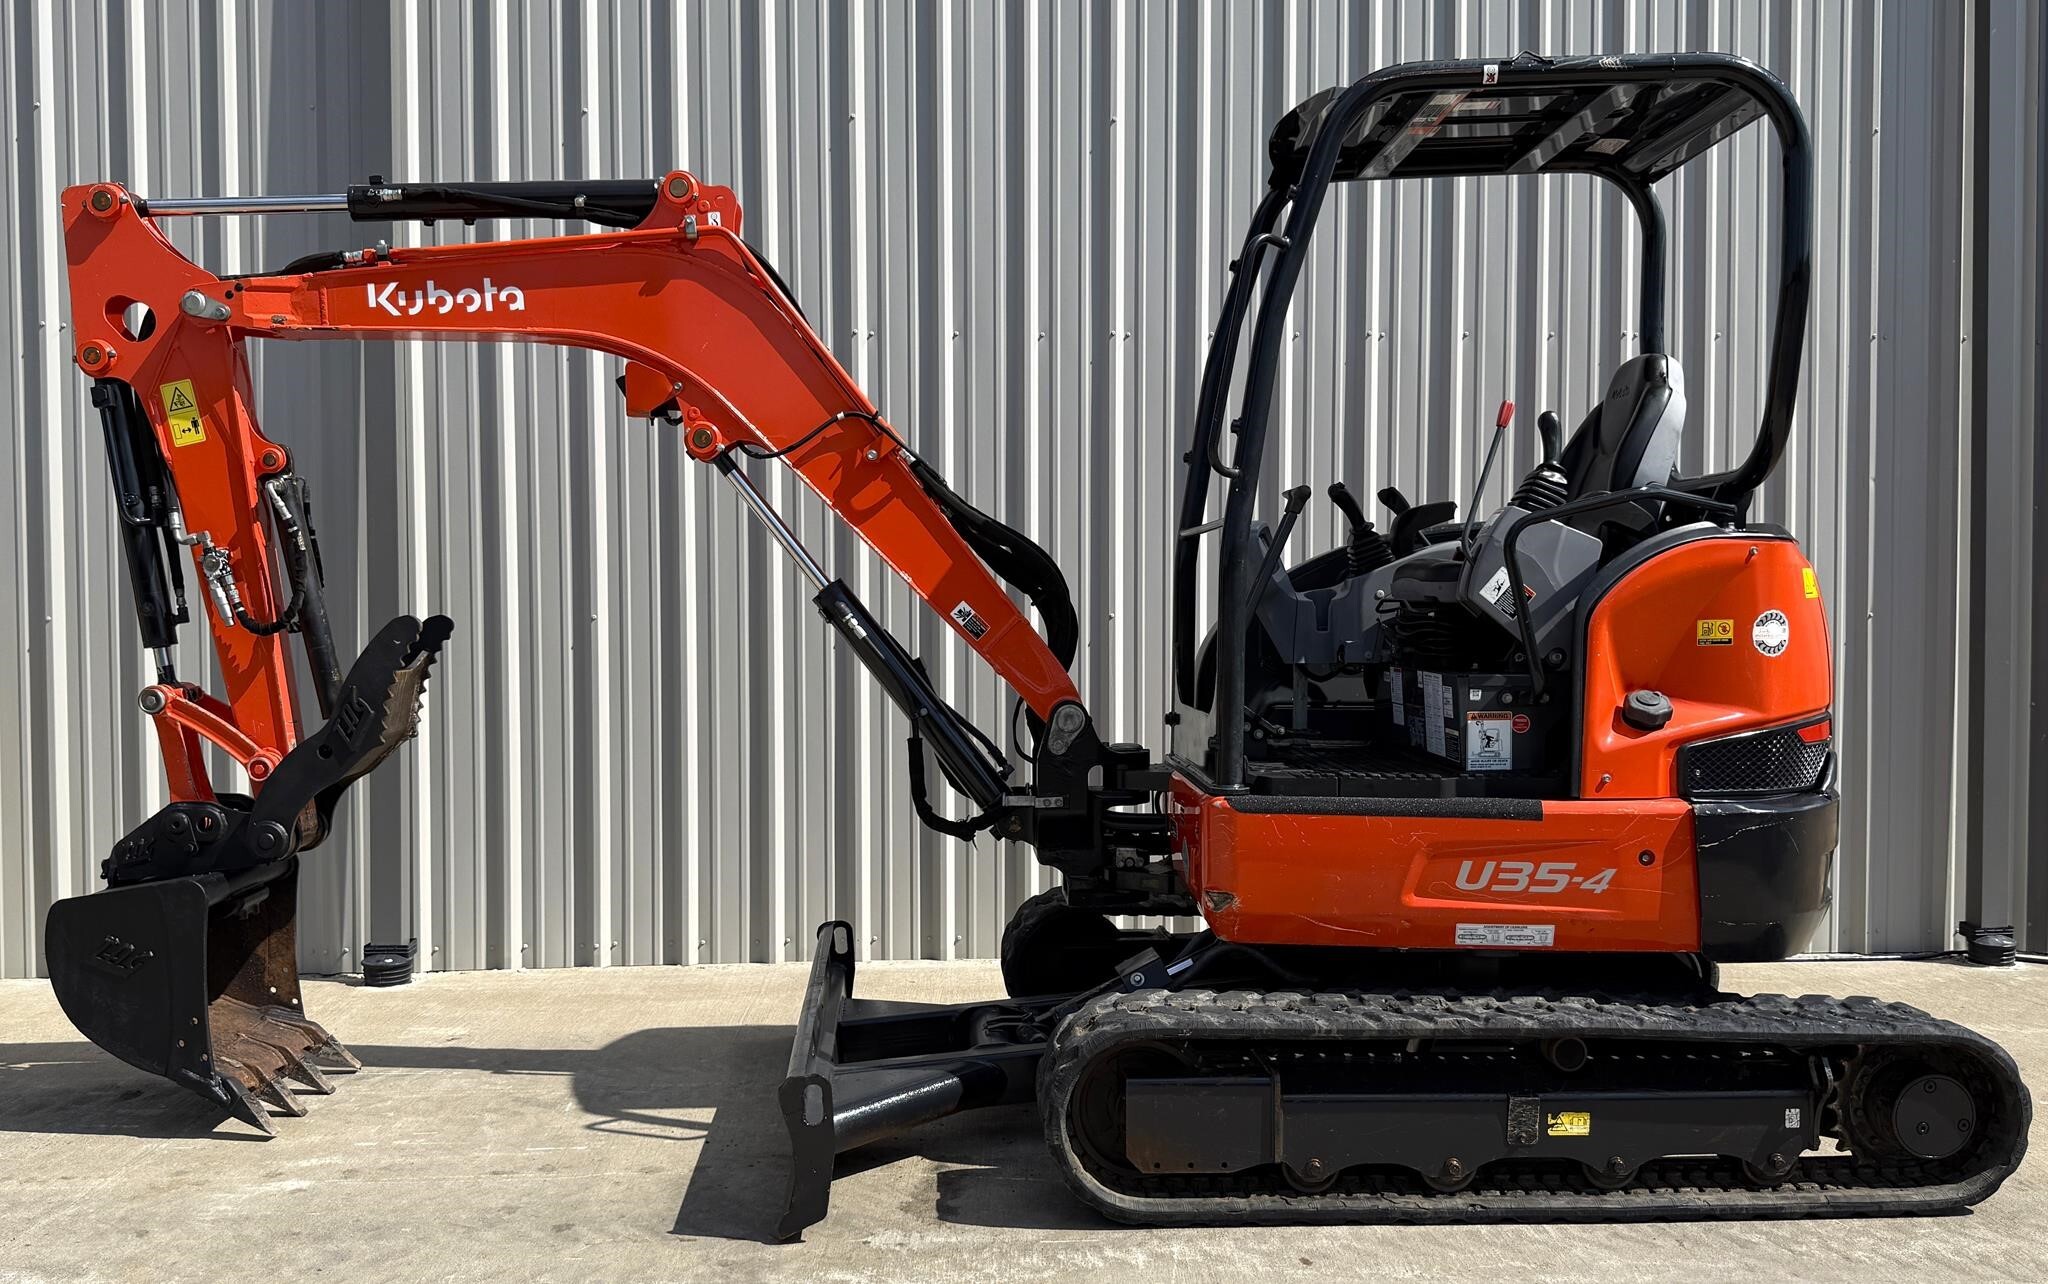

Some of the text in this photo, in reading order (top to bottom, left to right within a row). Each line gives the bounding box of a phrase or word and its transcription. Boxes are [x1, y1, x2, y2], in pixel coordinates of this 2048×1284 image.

[367, 277, 526, 317] Kubota
[1478, 712, 1509, 720] WARNING
[1455, 860, 1618, 894] U35-4
